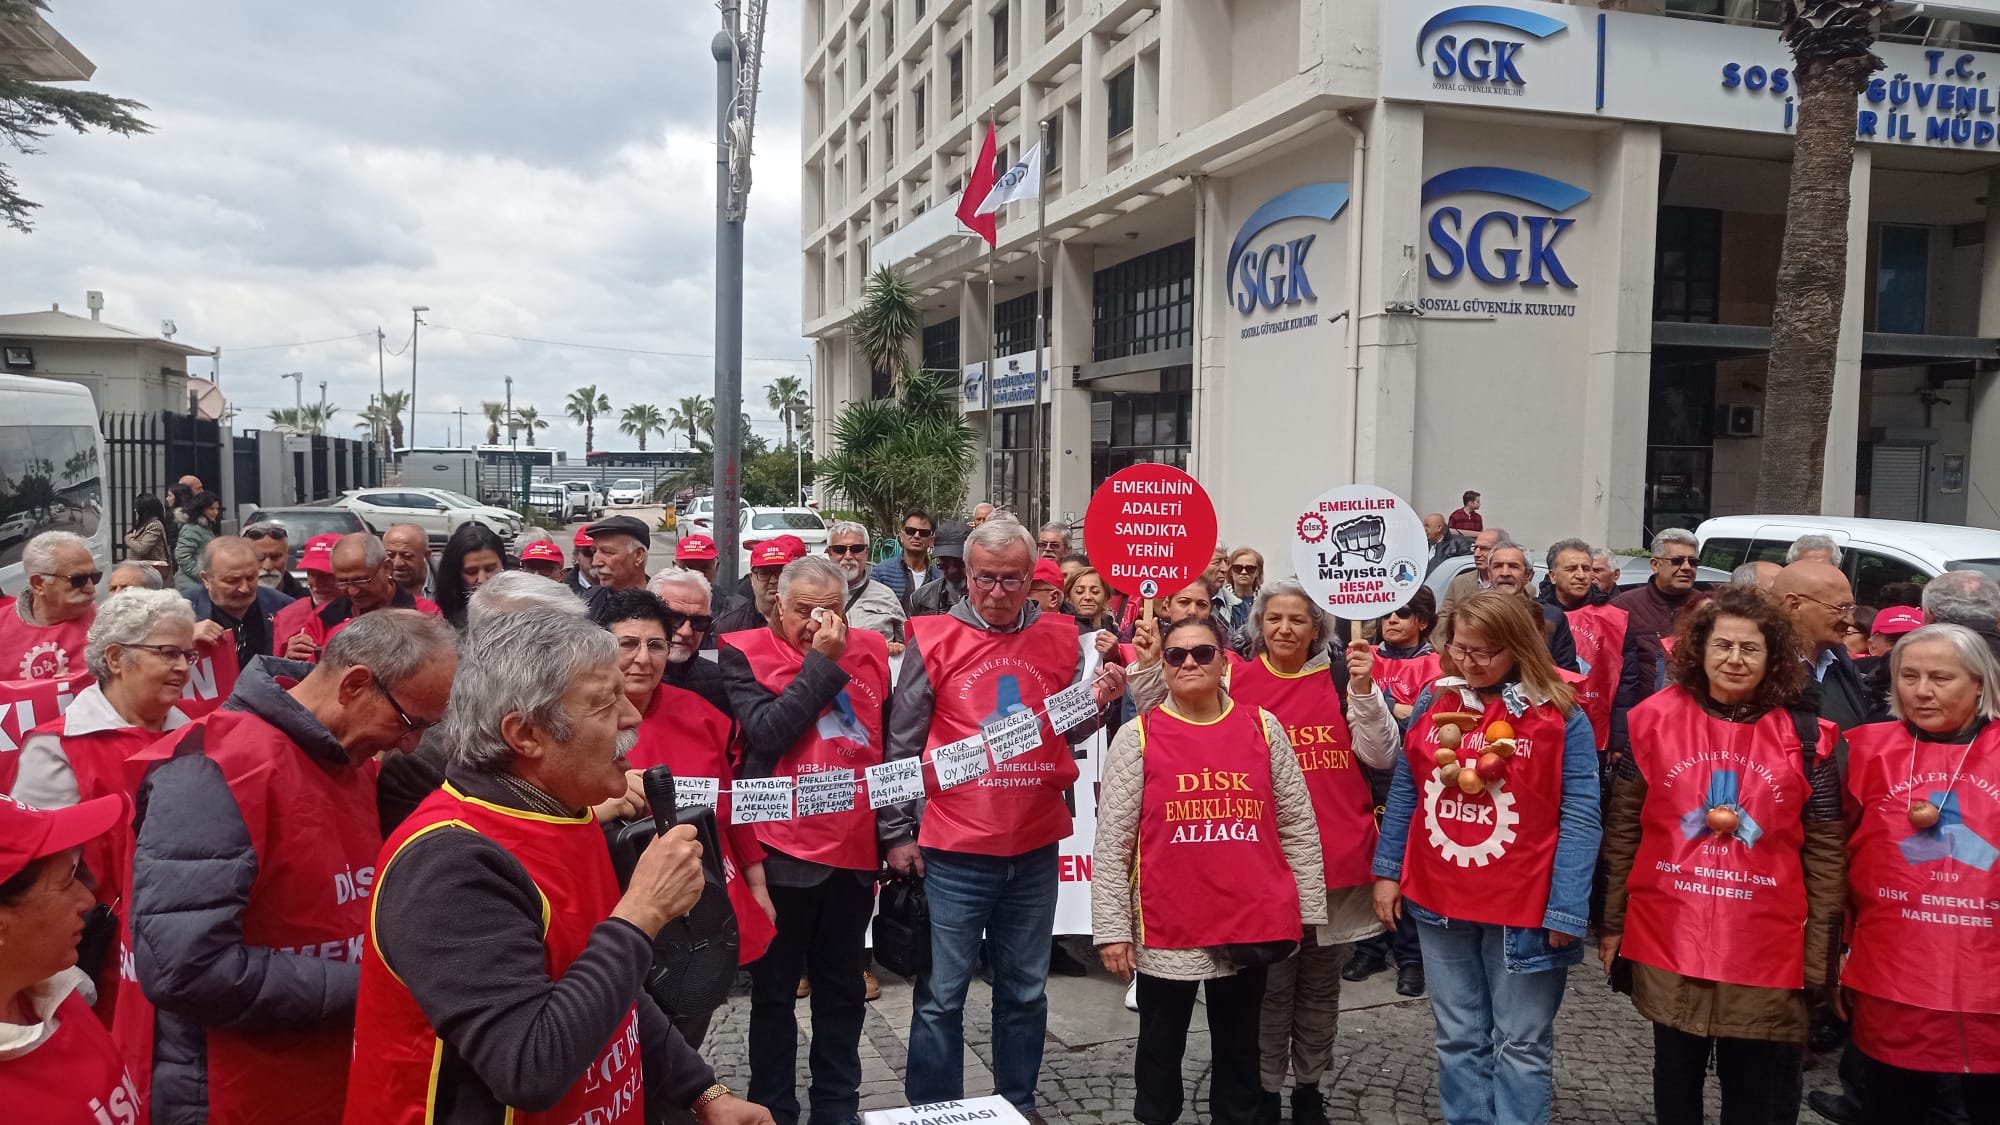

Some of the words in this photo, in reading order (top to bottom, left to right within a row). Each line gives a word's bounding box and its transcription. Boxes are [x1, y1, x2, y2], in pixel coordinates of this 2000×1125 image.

[1433, 34, 1526, 86] SGK
[1925, 50, 1986, 80] T.C.
[1432, 82, 1457, 91] SOSYAL
[1494, 87, 1524, 96] KURUMU
[1722, 62, 1789, 94] SOS
[1866, 72, 2000, 114] GÜVENL
[1926, 112, 2000, 145] MÜD
[1426, 206, 1579, 289] SGK
[1238, 234, 1318, 315] SGK
[1418, 297, 1460, 312] SOSYAL
[1463, 298, 1522, 316] GÜVENLİK
[1525, 303, 1576, 317] KURUMU
[1240, 326, 1260, 340] SOSYAL
[1260, 320, 1290, 337] GÜVENLİK
[1290, 314, 1318, 331] KURUMU
[1113, 479, 1193, 495] EMEKLİNİN
[1122, 500, 1182, 516] ADALETİ
[1319, 498, 1396, 512] EMEKLİLER
[1114, 522, 1188, 537] SANDIKTA
[1126, 542, 1174, 558] YERİNİ
[1318, 552, 1344, 568] 14
[1111, 564, 1178, 579] BULACAK
[1318, 567, 1387, 582] Mayısta
[1340, 580, 1384, 592] HESAP
[1328, 592, 1396, 604] SORACAK!
[959, 658, 1010, 700] EMEKLİLER
[1287, 724, 1337, 747] İSK
[1020, 740, 1038, 752] YOK
[944, 768, 958, 780] OY
[961, 761, 982, 775] YOK
[996, 760, 1056, 772] EMEKLİ-SEN
[879, 774, 896, 786] YOK
[898, 770, 918, 780] TEK
[978, 778, 1042, 788] KARŞIYAKA
[1176, 768, 1254, 792] DİSK
[1664, 750, 1729, 788] EMEKLİLER
[1733, 753, 1784, 803] SENDİKASI
[871, 785, 904, 800] BAŞINA
[1954, 774, 2000, 804] SENDİK
[1165, 792, 1264, 822] EMEKLİ-SEN
[1438, 794, 1494, 826] DİSK
[742, 812, 758, 821] OY
[767, 811, 790, 820] YOK
[1170, 818, 1260, 844] ALİAĞA
[1702, 844, 1728, 856] 2019
[1656, 860, 1682, 874] DİSK
[1694, 866, 1777, 887] EMEKLİ-SEN
[1929, 871, 1959, 882] 2019
[334, 864, 376, 904] DİS
[1674, 880, 1753, 900] NARLIDERE
[1878, 886, 1908, 902] DİSK
[1902, 908, 1993, 928] NARLIDERE
[910, 1101, 964, 1114] PARA
